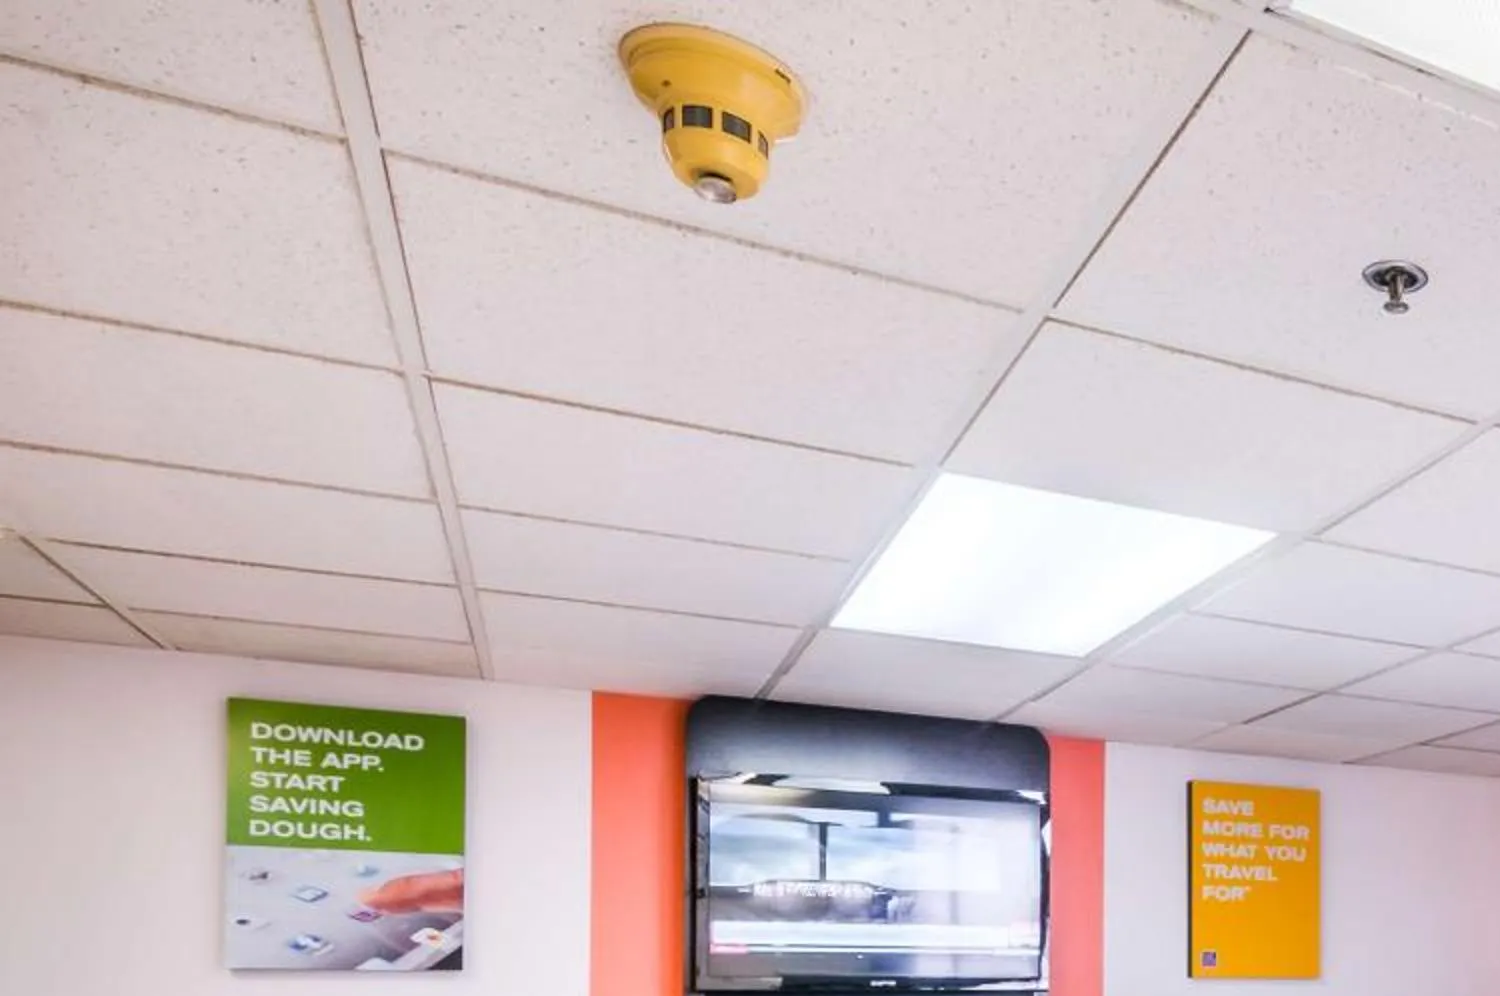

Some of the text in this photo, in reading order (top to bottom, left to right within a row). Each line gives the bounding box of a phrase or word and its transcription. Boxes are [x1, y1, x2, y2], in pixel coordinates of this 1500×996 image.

[251, 722, 425, 751] DOWNLOAD
[250, 747, 385, 772] THE APP.
[250, 771, 345, 792] START
[250, 794, 364, 817] SAVING
[1202, 797, 1254, 816] SAVE
[249, 820, 373, 842] DOUGH.
[1202, 821, 1310, 841] MORE FOR
[1202, 843, 1307, 862] WHAT YOU
[1202, 864, 1278, 881] TRAVEL
